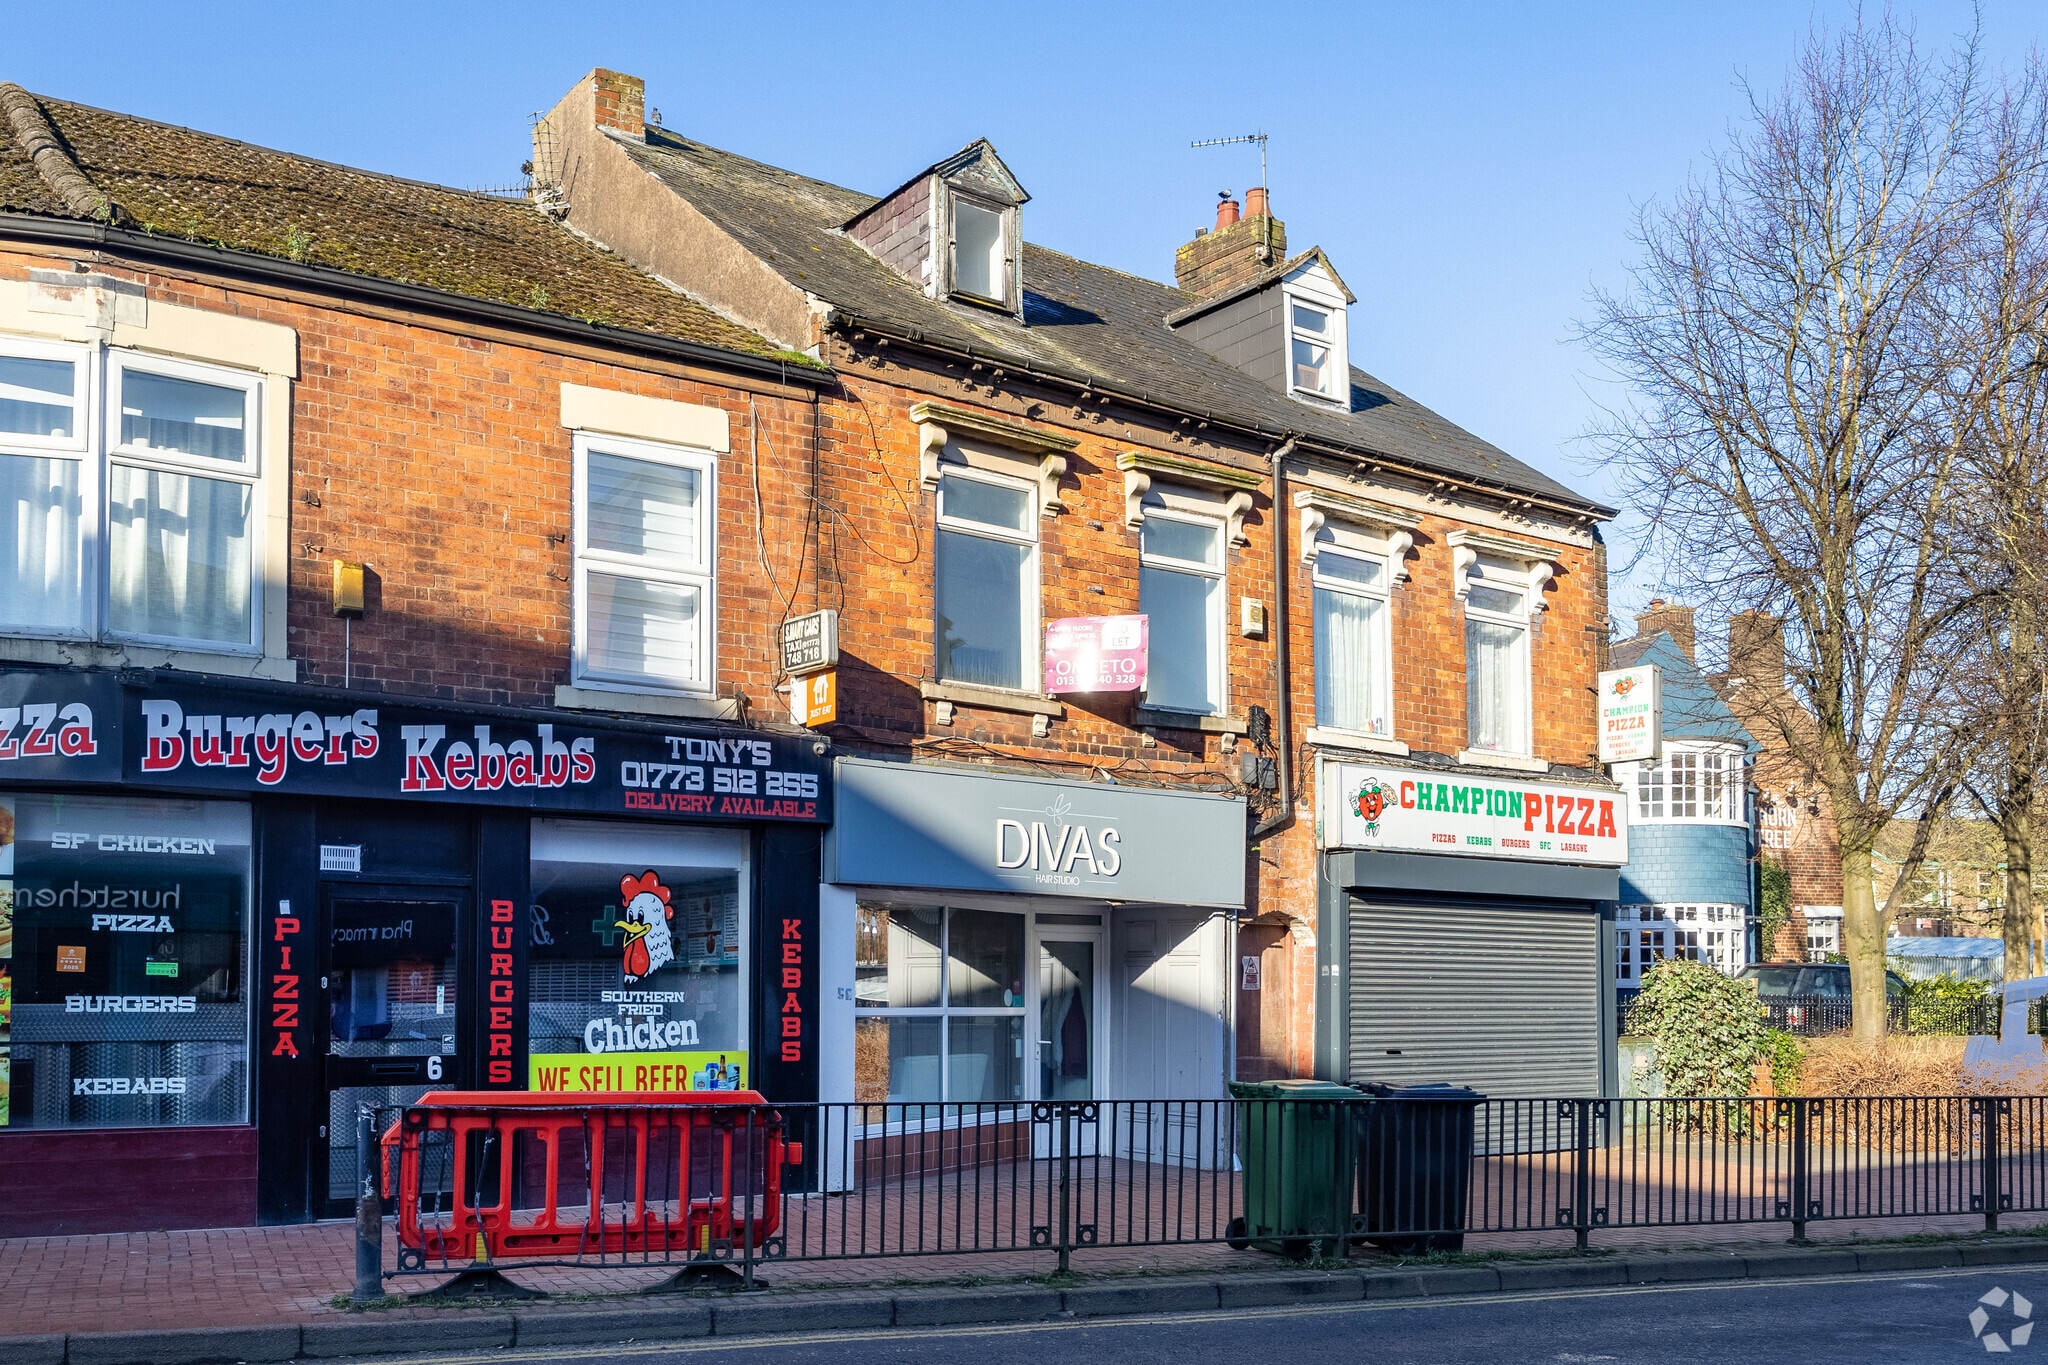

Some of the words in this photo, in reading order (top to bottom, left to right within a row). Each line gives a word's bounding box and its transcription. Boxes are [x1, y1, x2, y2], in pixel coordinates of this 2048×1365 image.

[785, 621, 804, 642] SMART
[804, 617, 820, 637] CARS
[785, 641, 802, 653] TAXI
[1113, 636, 1130, 646] LET
[786, 652, 802, 666] 748
[803, 646, 820, 663] 718
[1115, 674, 1136, 684] 328
[809, 709, 821, 720] JUST
[821, 704, 832, 715] EAT
[1603, 704, 1649, 717] CHAMPION
[1607, 716, 1645, 732] PIZZA
[141, 699, 379, 785] Burgers
[400, 723, 597, 792] Kebabs
[665, 736, 772, 766] TONY'S
[621, 761, 704, 791] 01773
[713, 766, 757, 794] 512
[765, 771, 819, 798] 255
[625, 791, 715, 813] DELIVERY
[720, 796, 817, 818] AVAILABLE
[51, 832, 90, 850] SF
[98, 834, 216, 855] CHICKEN
[996, 818, 1122, 877] DIVAS
[1431, 833, 1457, 844] PIZZAS
[1466, 835, 1492, 846] KEBABS
[1501, 838, 1530, 849] BURGERS
[1539, 841, 1552, 850] SFC
[1560, 842, 1588, 853] LASAGNE
[1035, 874, 1053, 885] HAIR
[1053, 874, 1080, 887] STUDIO
[92, 914, 175, 933] PIZZA
[272, 917, 301, 1056] PIZZA
[488, 899, 514, 1084] BURGERS
[601, 990, 685, 1003] SOUTHERN
[781, 918, 802, 1062] KEBABS
[65, 995, 197, 1014] BURGERS
[617, 1004, 664, 1016] FRIED
[584, 1015, 700, 1054] Chicken
[427, 1055, 443, 1080] 6
[537, 1066, 571, 1091] WE
[635, 1064, 687, 1091] BEER
[73, 1077, 187, 1096] KEBABS
